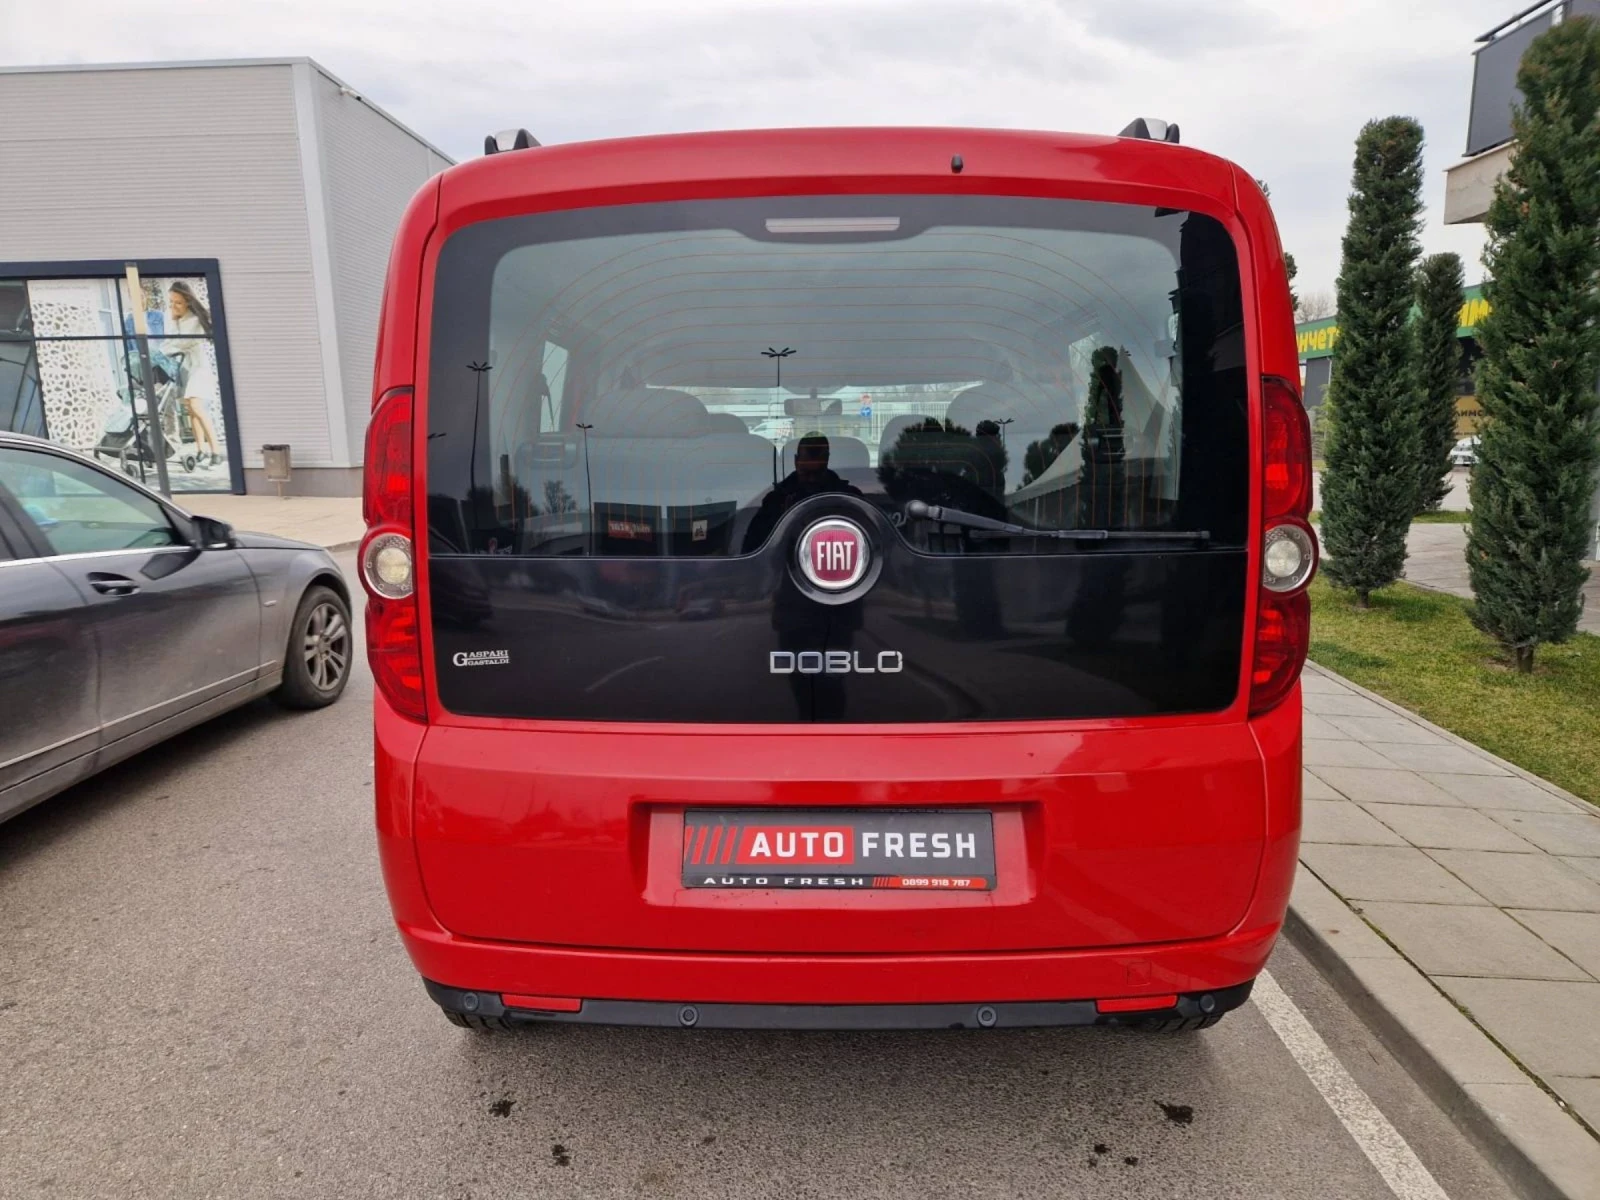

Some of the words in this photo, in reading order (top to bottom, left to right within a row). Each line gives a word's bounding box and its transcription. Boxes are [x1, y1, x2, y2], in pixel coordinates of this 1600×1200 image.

[816, 541, 854, 571] FIAT
[769, 651, 903, 673] DOBLO
[749, 832, 845, 858] AUTO
[862, 832, 976, 859] FRESH
[703, 877, 769, 886] AUTO
[784, 877, 864, 886] FRESH
[902, 878, 929, 887] 0899
[931, 879, 949, 887] 918
[951, 879, 971, 888] 787
